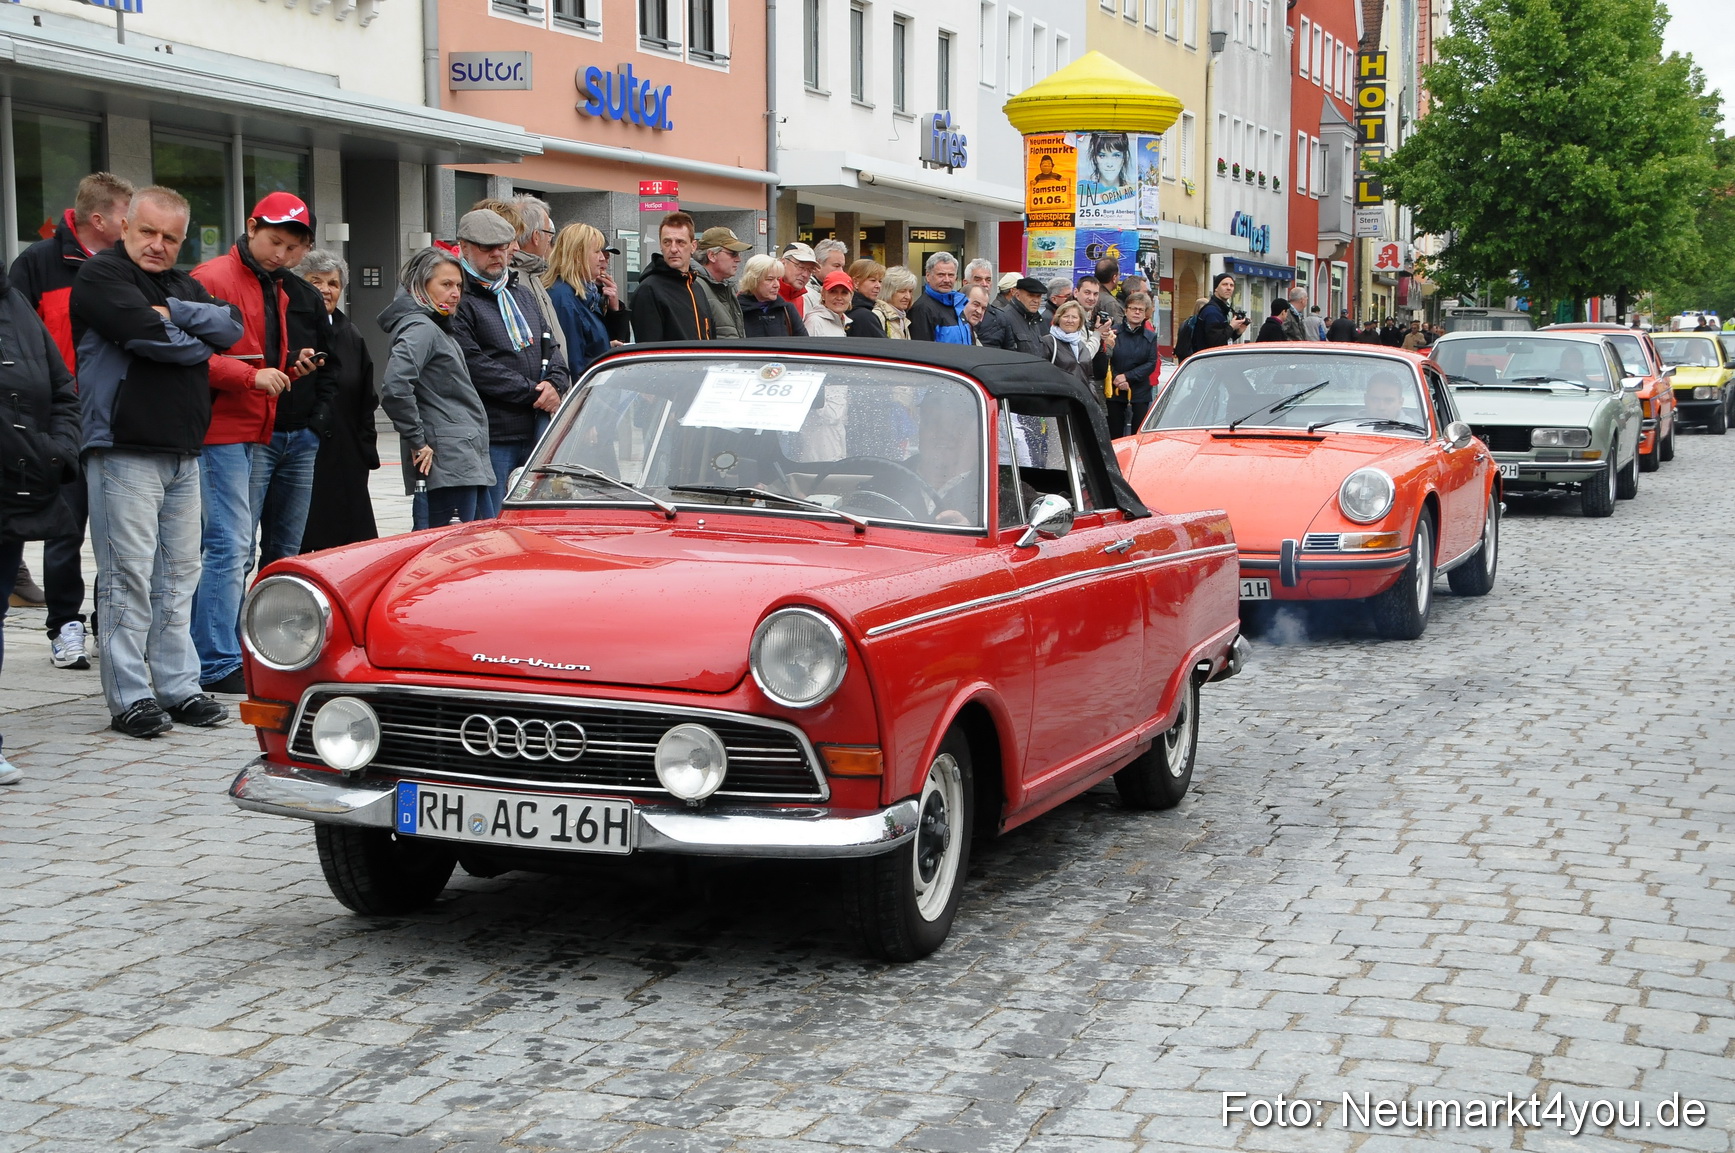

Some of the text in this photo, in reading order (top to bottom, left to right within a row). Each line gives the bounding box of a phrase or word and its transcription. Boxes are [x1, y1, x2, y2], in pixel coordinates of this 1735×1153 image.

[1358, 54, 1385, 203] HOTEL
[931, 110, 968, 168] fries
[1030, 146, 1075, 155] Flohmarkt
[1032, 185, 1067, 194] Samstag
[1079, 182, 1099, 208] ZAZ
[1101, 190, 1122, 204] OPEN
[1124, 187, 1135, 199] AIR
[1033, 196, 1065, 205] 01.06.
[1079, 208, 1103, 218] 25.6.
[910, 230, 946, 240] FRIES
[752, 383, 793, 397] 268
[1240, 582, 1268, 597] 1H
[403, 812, 411, 824] D
[419, 791, 628, 846] RH AC 16H
